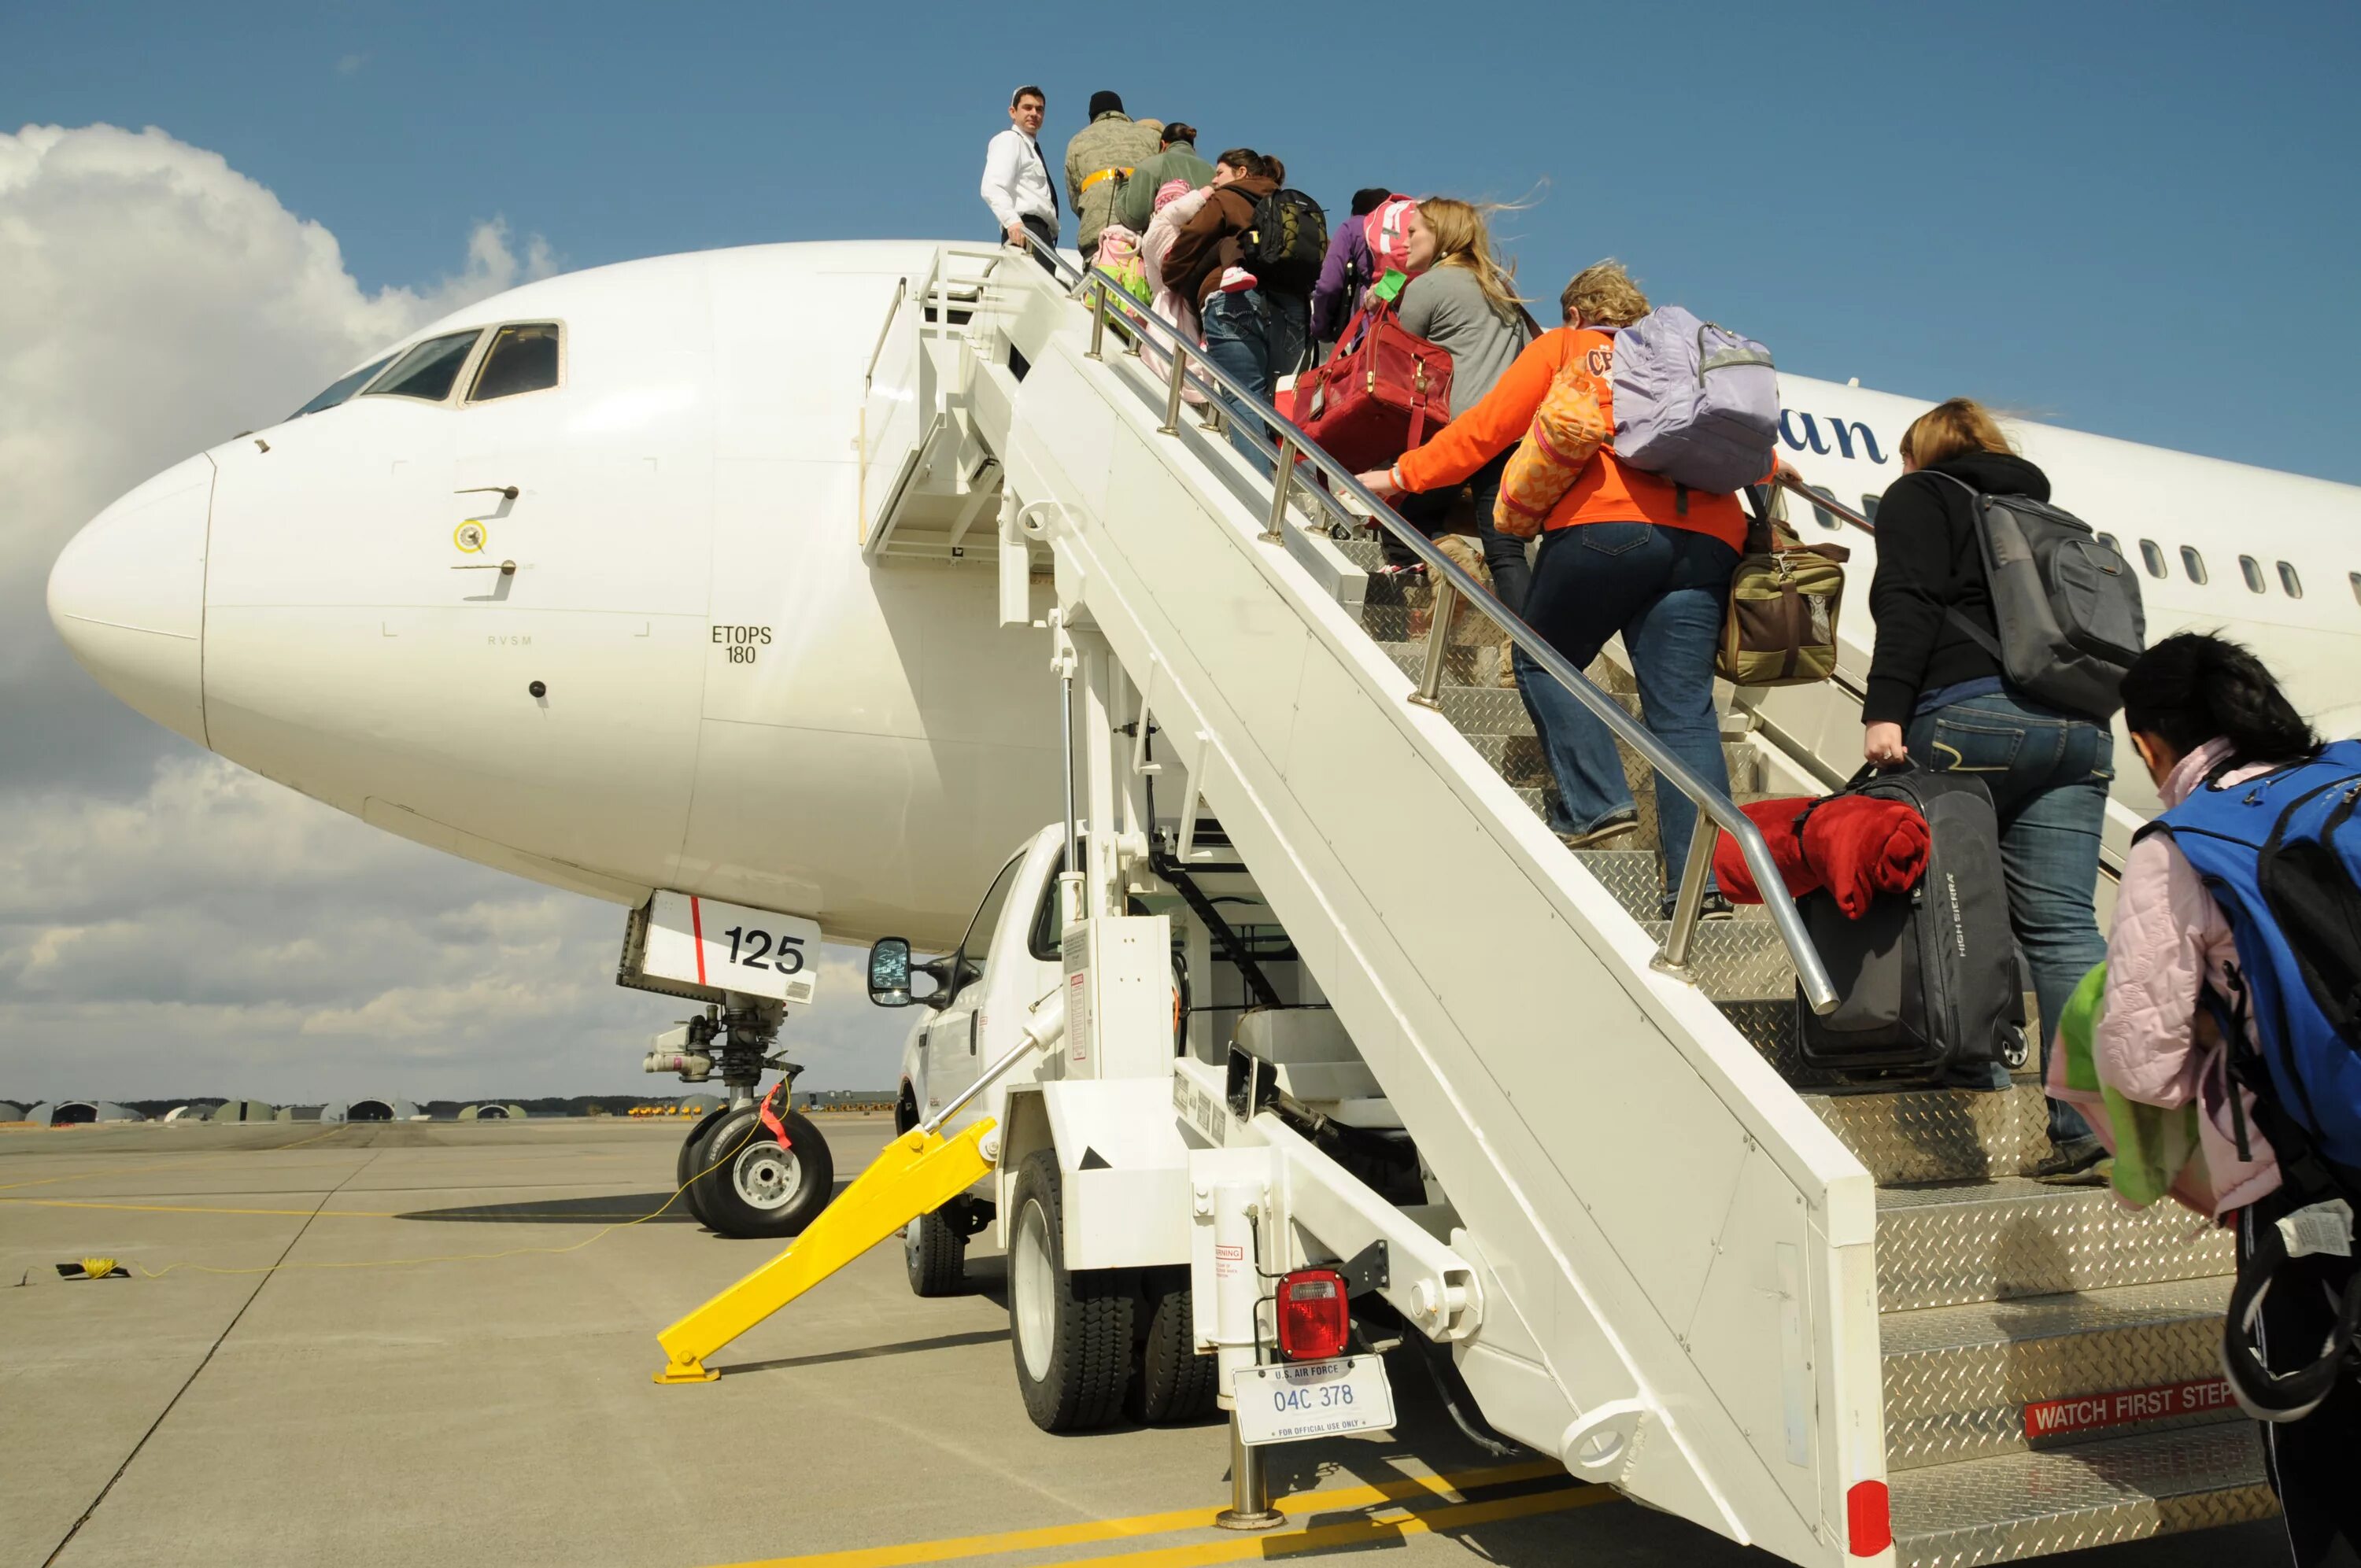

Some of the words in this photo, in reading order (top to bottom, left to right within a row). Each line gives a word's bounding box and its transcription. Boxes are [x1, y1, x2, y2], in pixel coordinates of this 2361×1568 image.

[488, 636, 532, 646] RVSM
[711, 625, 772, 645] ETOPS
[725, 646, 756, 664] 180
[1945, 872, 1961, 922] SIERRA
[724, 925, 805, 975] 125
[1955, 924, 1967, 957] HIGH
[1275, 1369, 1292, 1380] U.S.
[1295, 1367, 1309, 1378] AIR
[1311, 1364, 1339, 1376] FORCE
[1274, 1389, 1312, 1412] 04C
[1319, 1384, 1354, 1407] 378
[2034, 1399, 2107, 1430] WATCH
[2115, 1389, 2174, 1419] FIRST
[2182, 1382, 2233, 1408] STEP
[1278, 1428, 1293, 1437] FOR
[1295, 1425, 1325, 1435] OFFICIAL
[1342, 1419, 1359, 1429] ONLY
